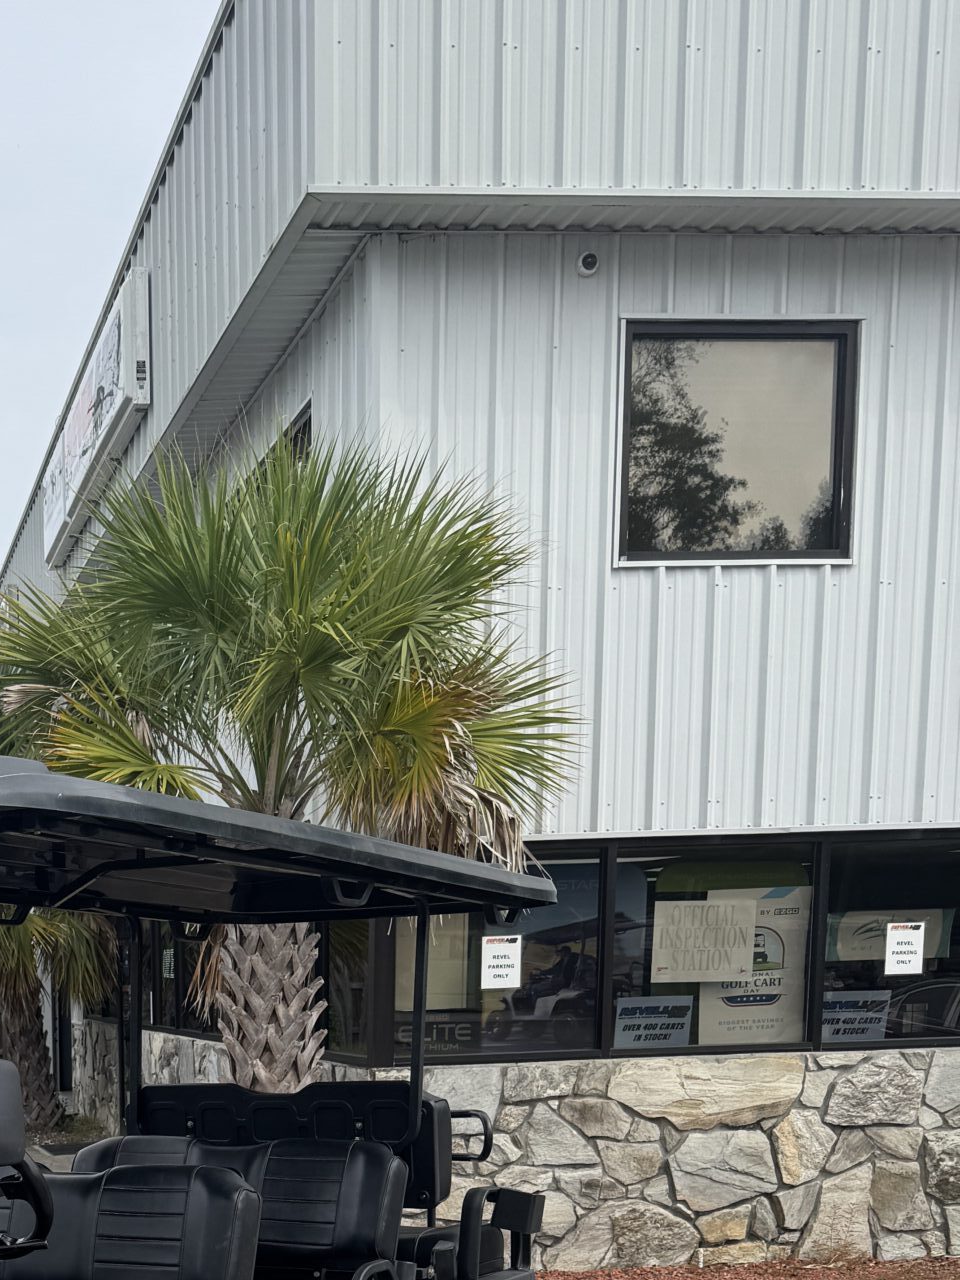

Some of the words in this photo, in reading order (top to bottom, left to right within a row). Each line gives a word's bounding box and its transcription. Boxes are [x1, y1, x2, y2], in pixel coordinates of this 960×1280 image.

[671, 904, 739, 927] OFFICIAL
[659, 926, 749, 949] INSPECTION
[670, 949, 733, 971] STATION
[721, 980, 752, 989] GOLF
[753, 977, 785, 988] CART
[857, 1016, 883, 1025] CARTS
[622, 1024, 642, 1032] OVER
[642, 1023, 658, 1031] 400
[659, 1022, 686, 1030] CARTS
[644, 1033, 672, 1042] STOCK!
